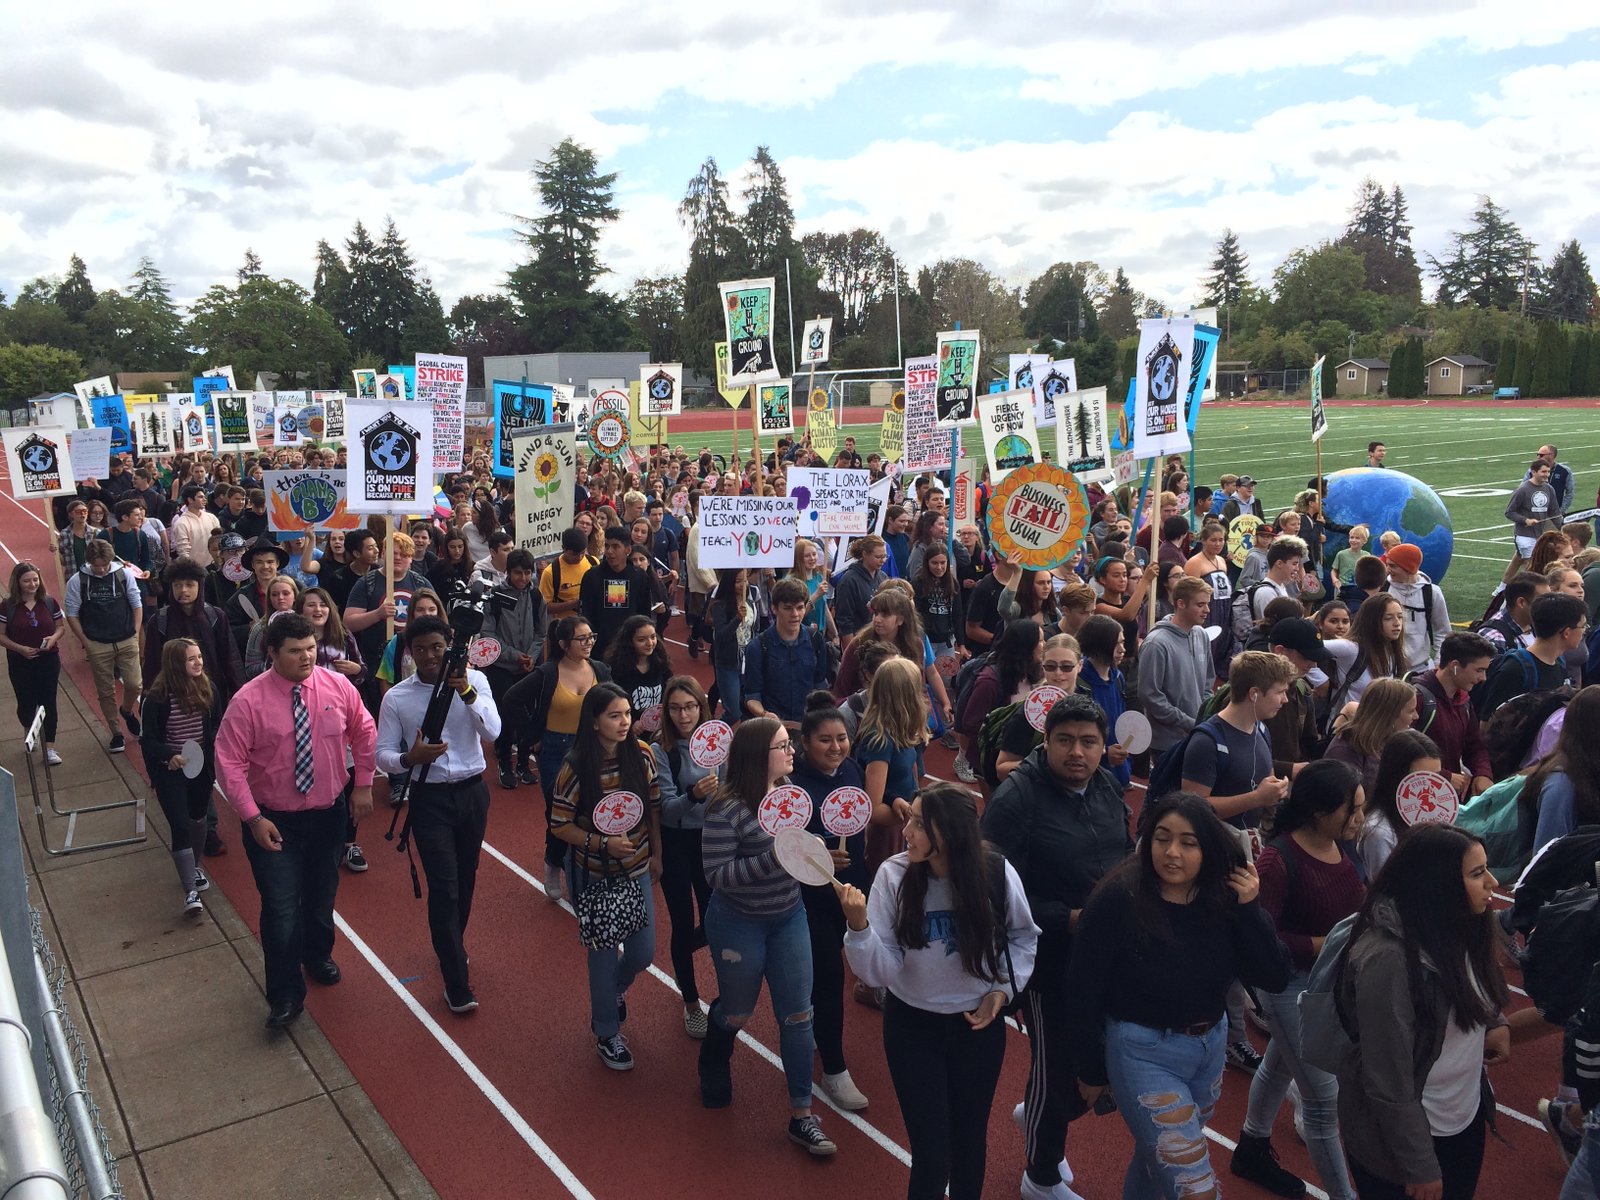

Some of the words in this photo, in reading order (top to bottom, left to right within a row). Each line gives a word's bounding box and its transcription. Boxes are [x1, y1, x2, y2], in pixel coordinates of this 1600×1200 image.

[740, 296, 758, 309] KEEP
[738, 339, 762, 354] GROUND
[951, 347, 966, 358] KEEP
[418, 367, 464, 382] STRIKE
[908, 370, 938, 383] STR
[945, 388, 968, 401] GROUND
[597, 399, 626, 410] FOSSIL
[996, 402, 1019, 414] FIERCE
[1148, 407, 1159, 416] OUR
[1160, 405, 1177, 415] HOUSE
[506, 415, 519, 426] LET
[523, 419, 540, 427] THE
[810, 411, 833, 421] YOUTH
[991, 411, 1024, 424] URGENCY
[1147, 417, 1153, 426] IS
[1154, 416, 1164, 424] ON
[1165, 415, 1176, 423] FIRE
[364, 421, 380, 432] WANT
[380, 413, 392, 422] YOU
[394, 416, 403, 424] TO
[404, 424, 418, 434] ACT
[995, 423, 1005, 432] OF
[1006, 421, 1023, 431] NOW
[1064, 405, 1073, 444] ATMOSPHERE
[1147, 425, 1166, 434] BECAUSE
[811, 428, 836, 437] CLIMATE
[813, 438, 837, 448] JUSTICE
[518, 438, 542, 473] WIND
[545, 435, 552, 446] &
[554, 440, 573, 467] SUN
[276, 473, 312, 494] there
[320, 471, 330, 479] is
[333, 479, 346, 488] no
[366, 475, 384, 484] OUR
[386, 476, 415, 484] HOUSE
[809, 472, 830, 487] THE
[836, 474, 869, 487] LORAX
[292, 480, 337, 512] PLANET
[816, 489, 839, 499] SPEAKS
[841, 490, 854, 499] FOR
[855, 490, 868, 499] THE
[1021, 484, 1066, 514] BUSINESS
[302, 498, 319, 520] B
[701, 498, 732, 511] WE'RE
[736, 500, 773, 513] MISSING
[776, 501, 794, 510] OUR
[811, 500, 827, 509] TREES
[528, 507, 563, 523] ENERGY
[705, 514, 747, 527] LESSONS
[754, 515, 765, 526] SO
[767, 517, 780, 525] WE
[782, 517, 796, 526] CAN
[1011, 499, 1061, 531] FAIL
[536, 522, 551, 533] FOR
[1010, 519, 1041, 546] USUAL
[521, 532, 562, 549] EVERYON
[701, 536, 732, 546] TEACH
[731, 531, 772, 556] YOU
[773, 539, 792, 548] ONE
[1412, 780, 1426, 789] FIRE
[774, 792, 787, 801] FIRE
[830, 824, 858, 832] EMERGENCY
